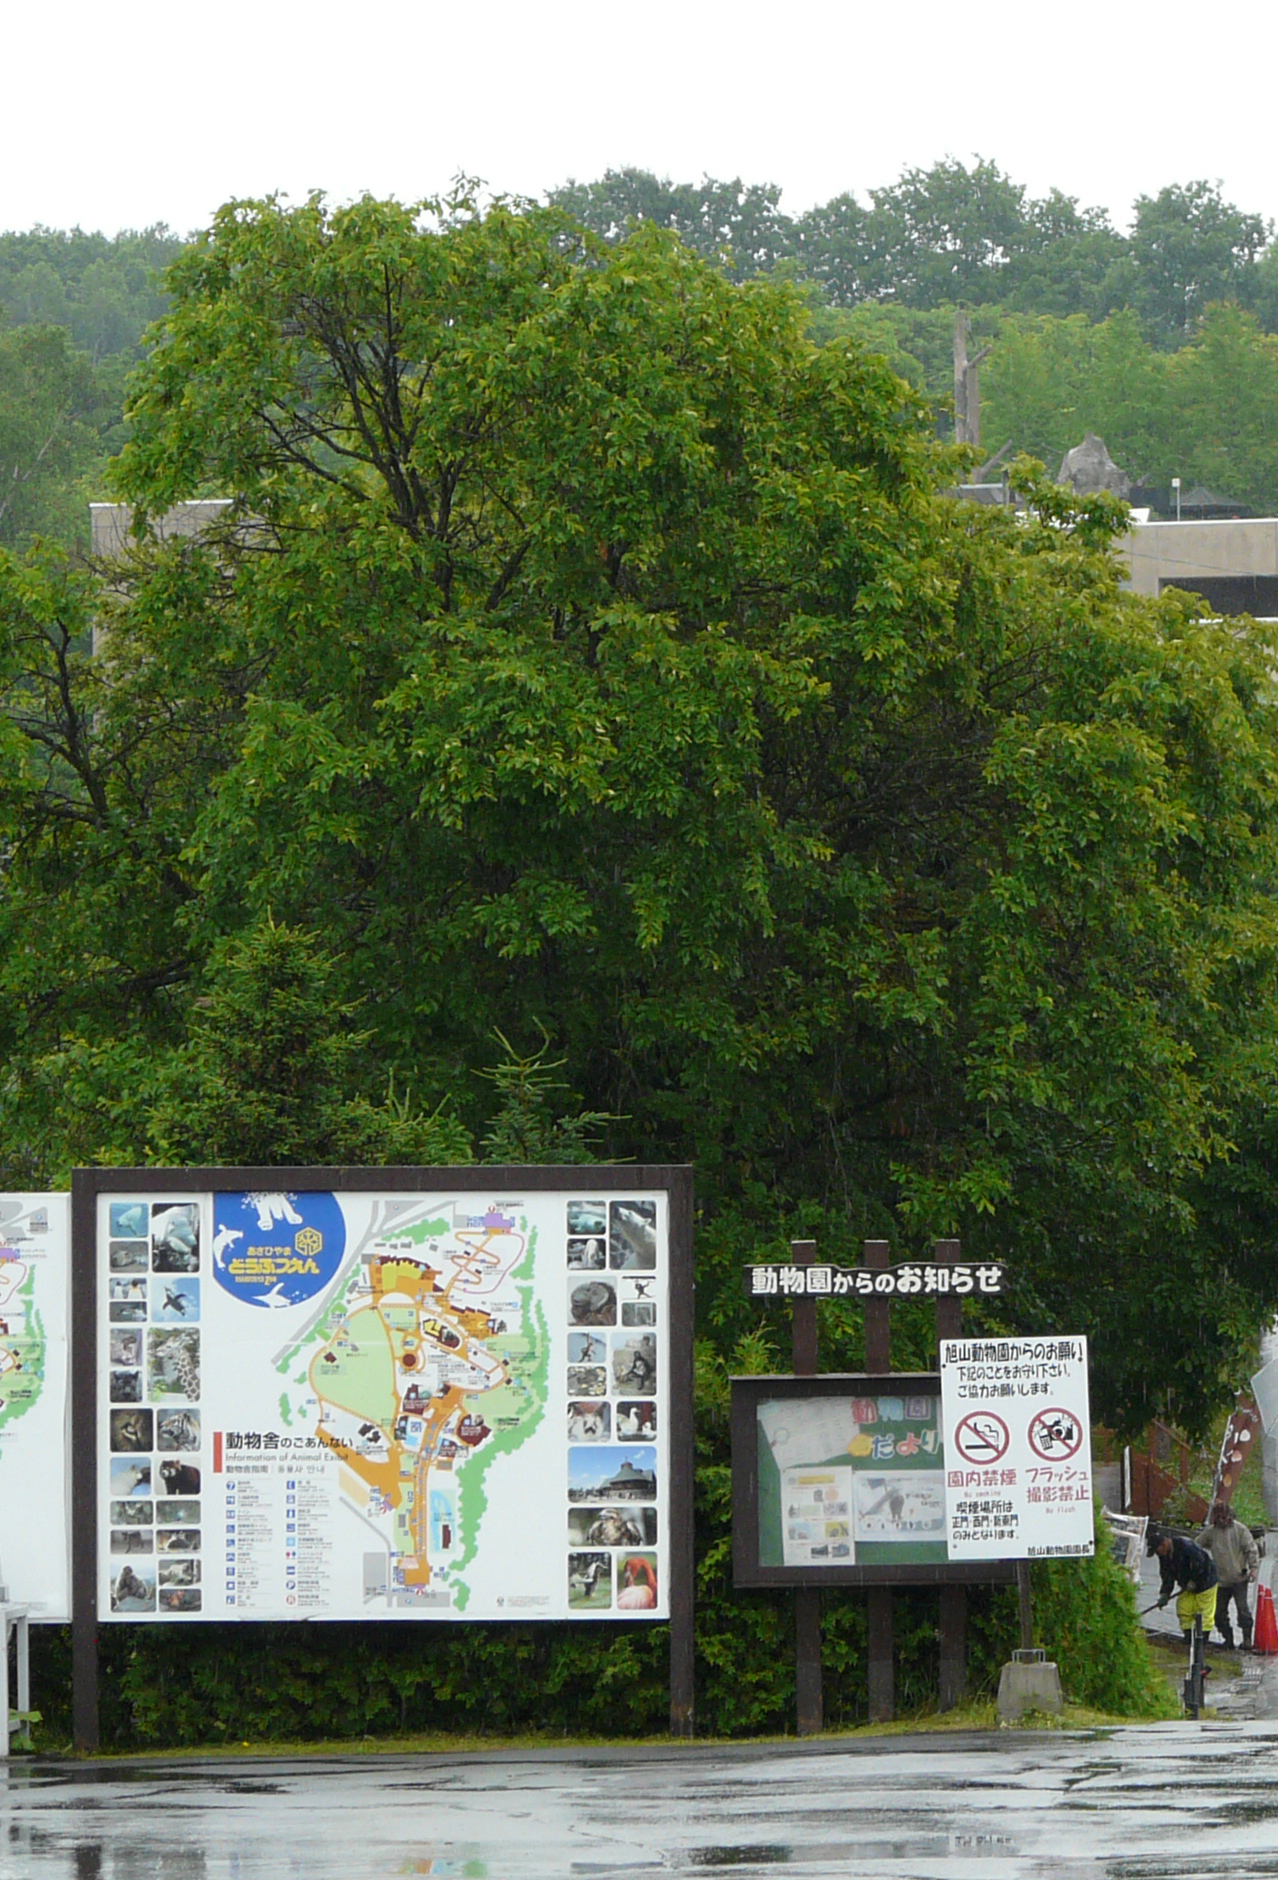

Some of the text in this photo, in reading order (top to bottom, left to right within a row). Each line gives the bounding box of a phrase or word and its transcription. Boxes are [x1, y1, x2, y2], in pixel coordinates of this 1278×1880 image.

[751, 1266, 1002, 1294] 動物園からのお知らせ
[225, 1431, 353, 1450] 動物舎のごあんない
[872, 1429, 940, 1459] だより
[225, 1452, 276, 1461] Information
[280, 1452, 288, 1461] of
[291, 1452, 321, 1461] Animal
[947, 1468, 1017, 1488] 園内禁煙
[1025, 1465, 1089, 1483] フラッシュ
[1026, 1485, 1090, 1503] 撮影禁止
[956, 1499, 1014, 1514] 喫煙場所は
